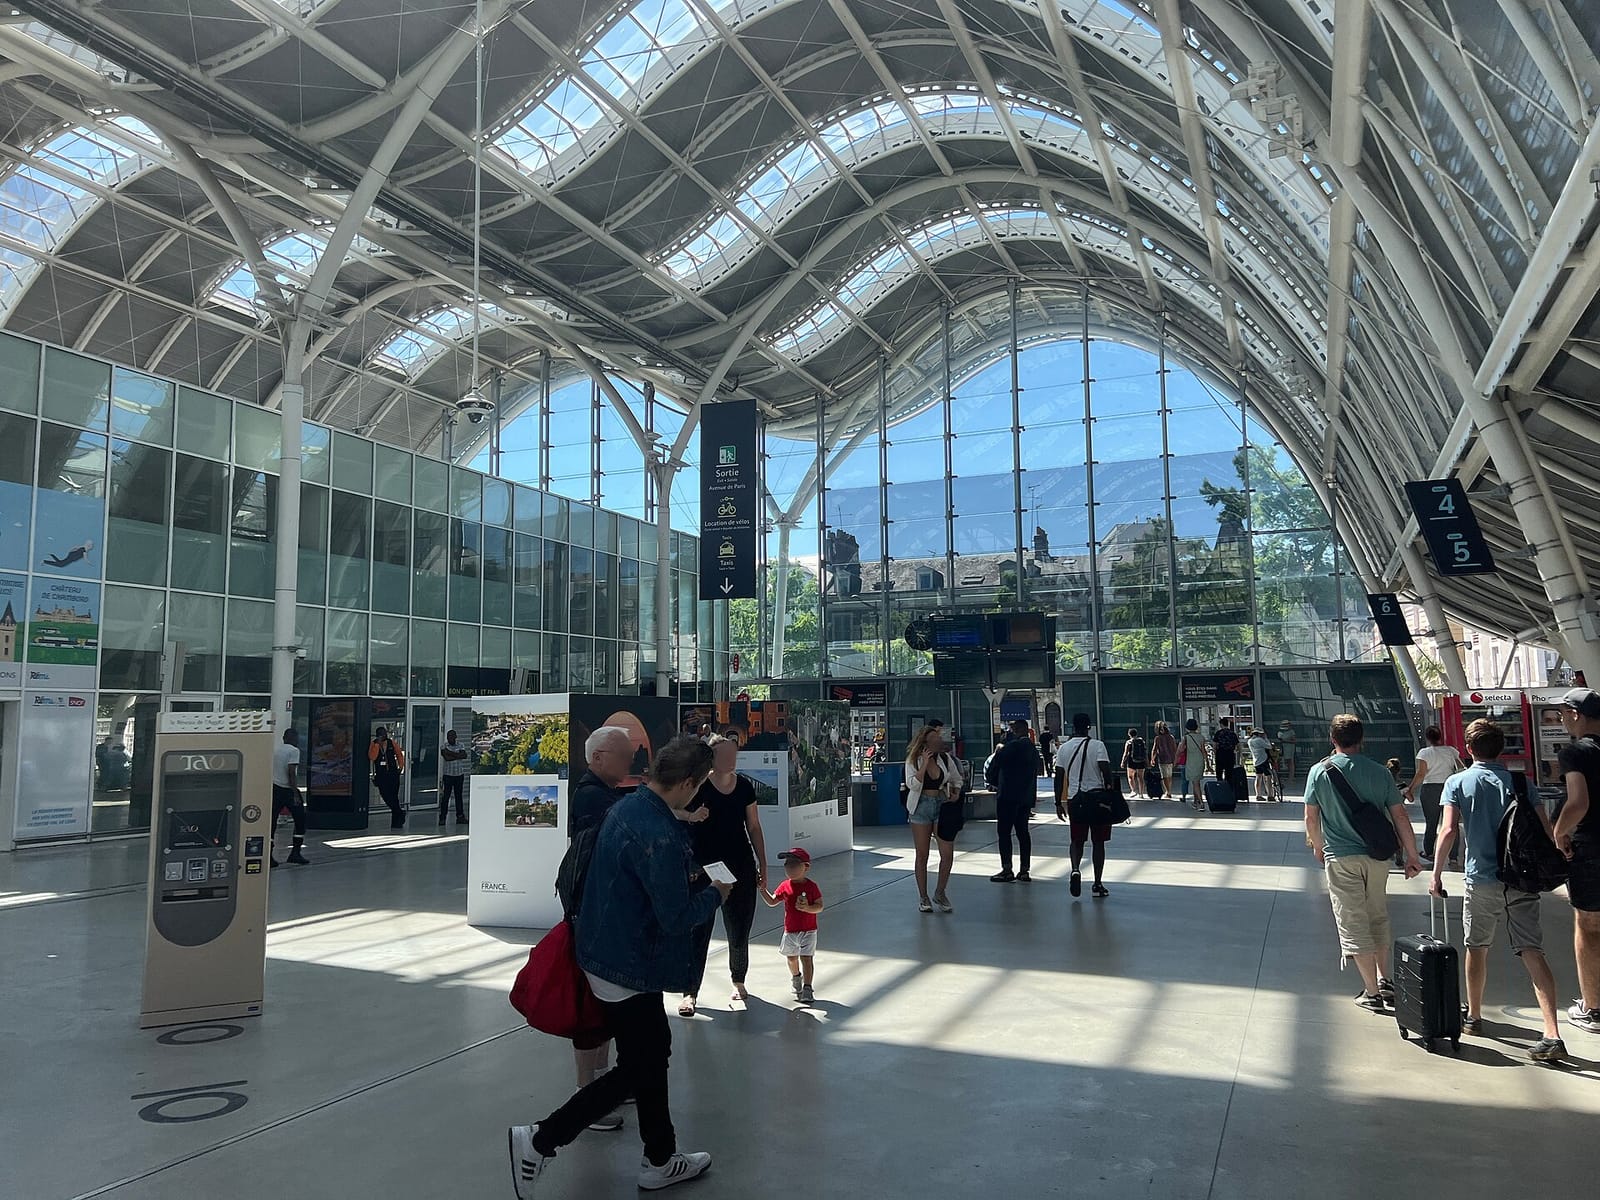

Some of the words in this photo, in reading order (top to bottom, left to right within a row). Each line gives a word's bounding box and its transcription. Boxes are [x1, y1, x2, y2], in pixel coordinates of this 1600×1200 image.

[715, 468, 739, 478] Sortie
[1438, 494, 1455, 514] 4
[1454, 541, 1470, 562] 5
[50, 584, 81, 593] CHÂTEAU
[52, 594, 89, 602] CHAMBORD
[1382, 601, 1390, 613] 6
[180, 755, 225, 770] TAO
